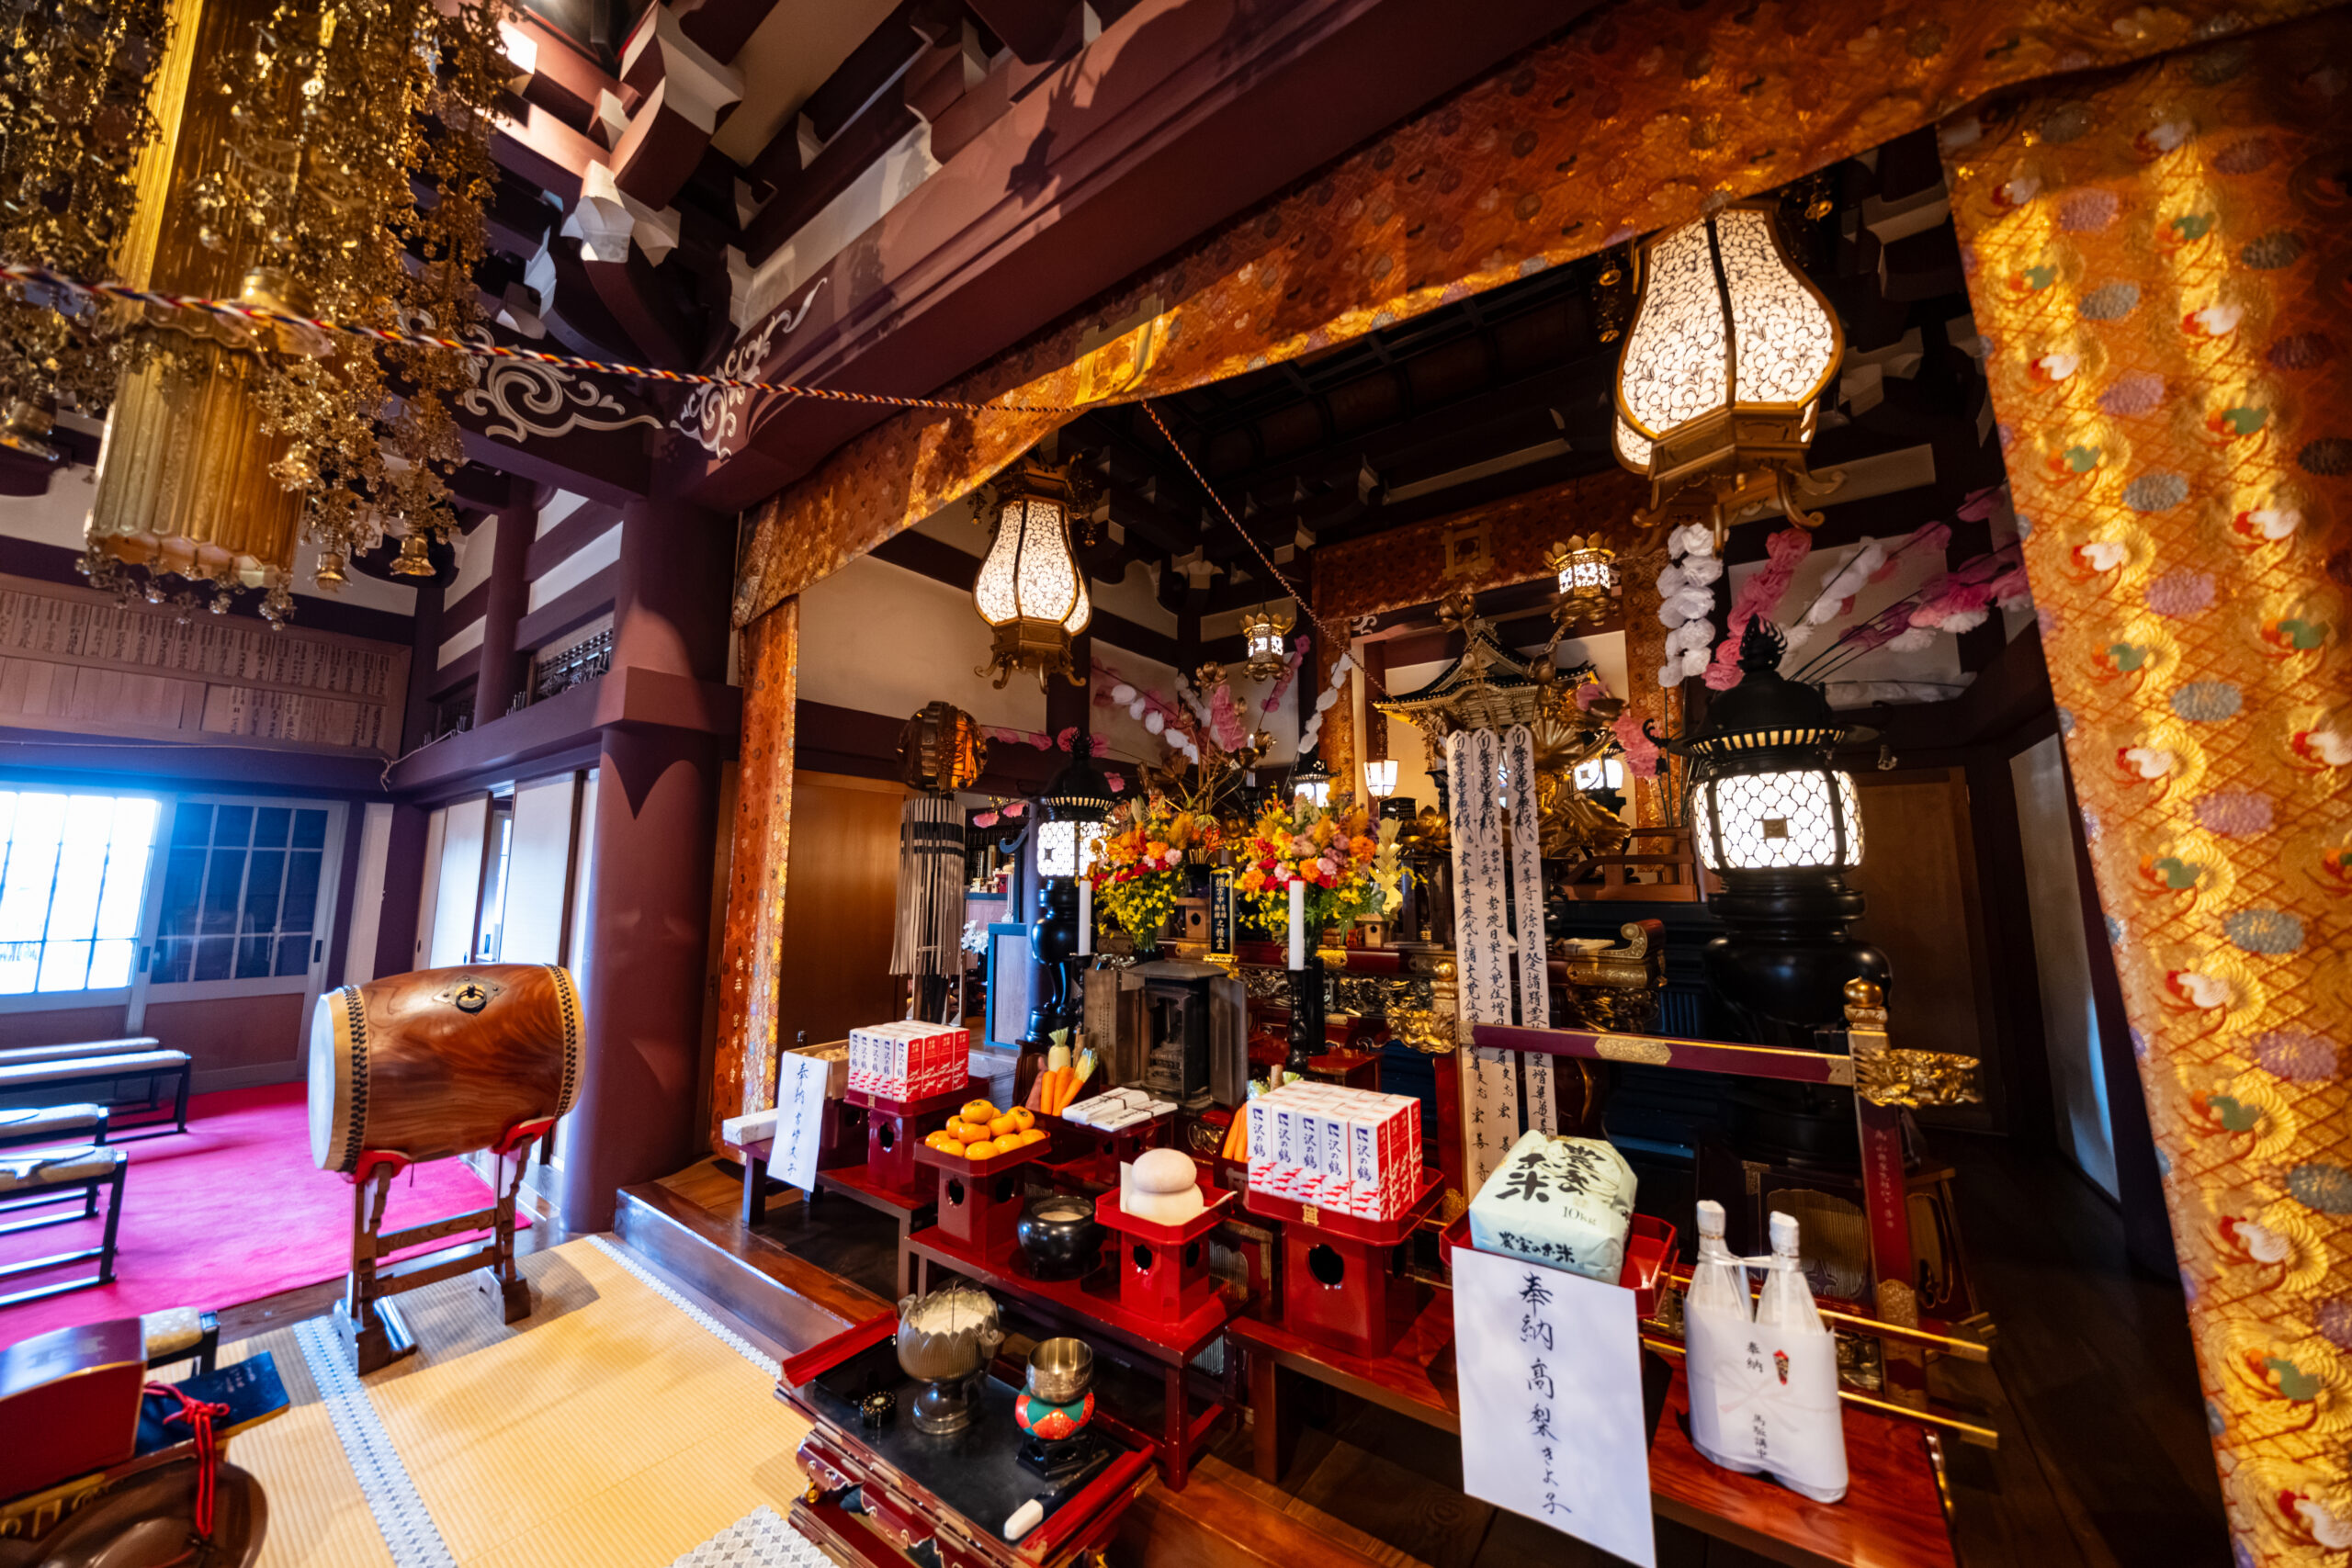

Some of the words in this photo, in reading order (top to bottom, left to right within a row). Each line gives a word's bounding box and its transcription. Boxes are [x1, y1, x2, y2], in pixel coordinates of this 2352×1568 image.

[1253, 1123, 1266, 1157] 沢の鶴
[1278, 1128, 1292, 1163] 沢の鶴
[1304, 1133, 1317, 1169] 沢の鶴
[1329, 1139, 1342, 1176] 沢の鶴
[1356, 1144, 1372, 1181] 沢の鶴
[1498, 1231, 1576, 1264] 農家のお米
[1518, 1271, 1555, 1351] 奉納
[1747, 1341, 1764, 1373] 奉納
